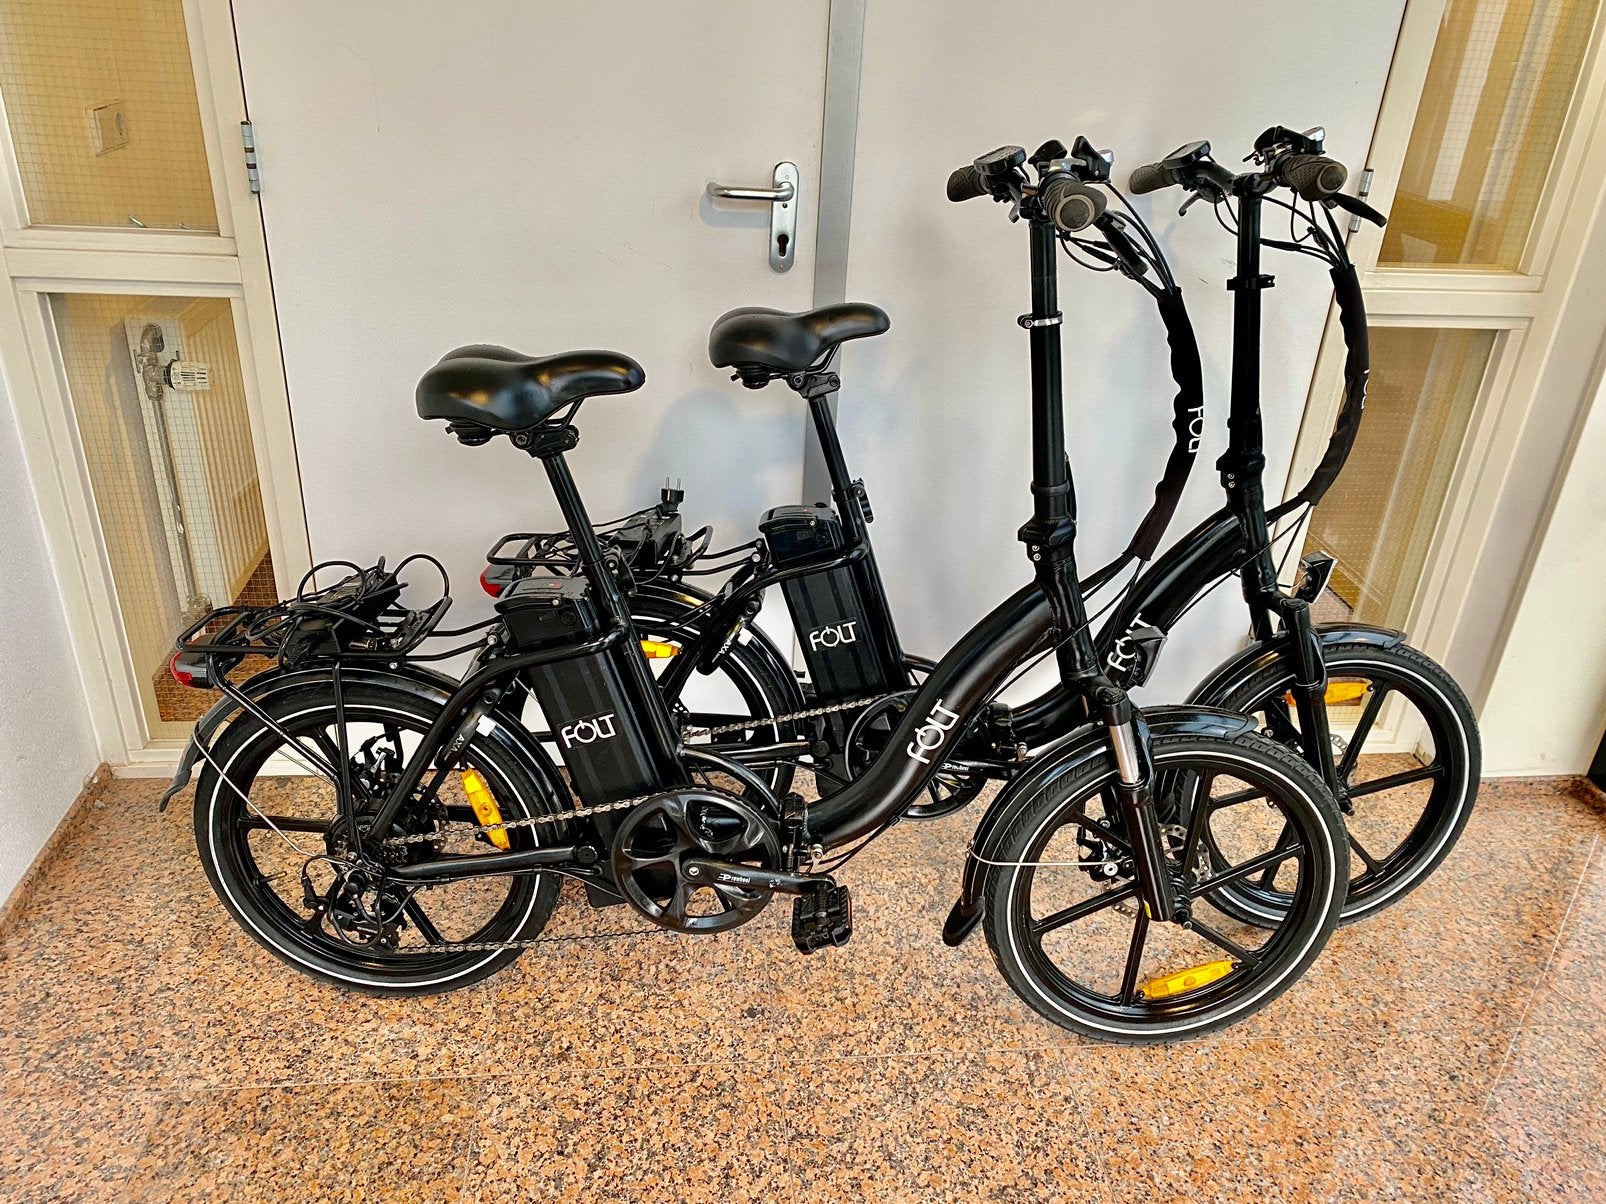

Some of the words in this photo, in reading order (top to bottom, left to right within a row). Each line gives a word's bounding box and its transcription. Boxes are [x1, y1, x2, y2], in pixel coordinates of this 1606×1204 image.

[719, 639, 732, 655] AXA
[809, 621, 857, 652] FOLT
[1106, 612, 1153, 672] FOT
[450, 733, 465, 752] AXA
[560, 713, 617, 749] FOLT
[906, 698, 960, 765] FOLT
